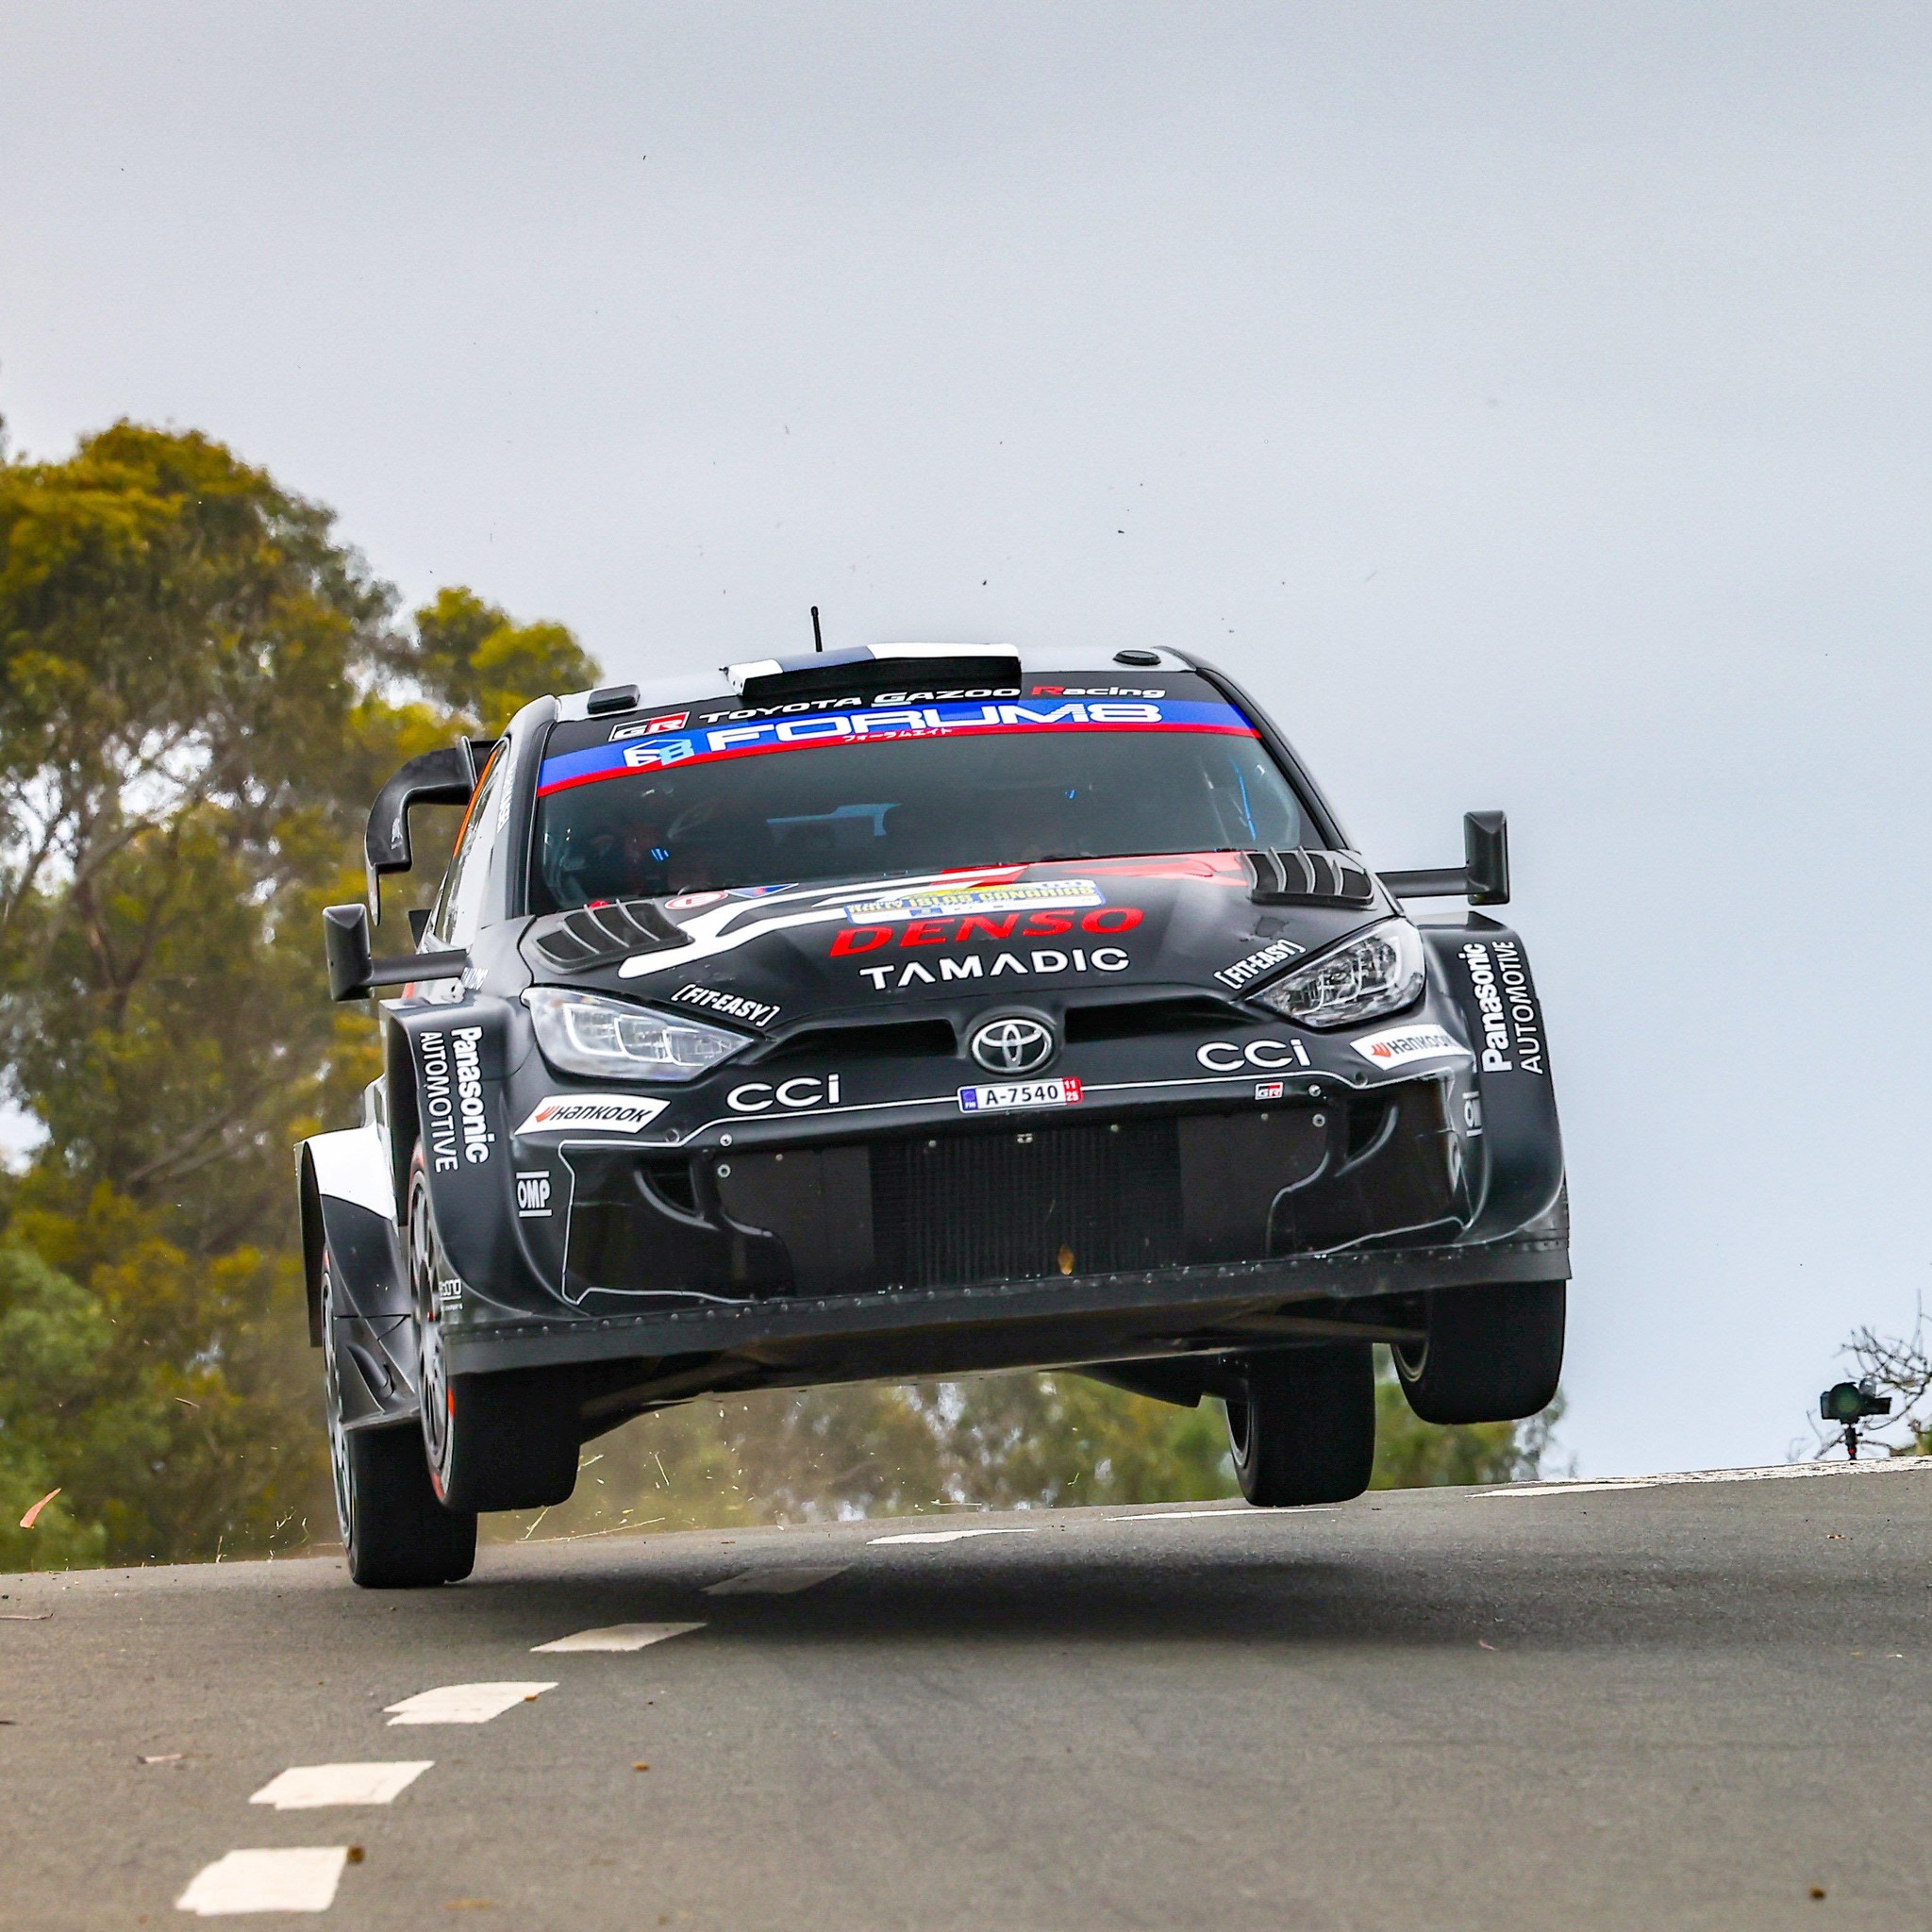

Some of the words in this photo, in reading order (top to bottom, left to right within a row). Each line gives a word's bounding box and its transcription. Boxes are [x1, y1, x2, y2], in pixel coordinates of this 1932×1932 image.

[699, 696, 863, 724] TOYOTA
[872, 687, 1022, 708] GAZOO
[1031, 685, 1167, 700] Racing
[611, 718, 685, 741] GR
[707, 703, 1162, 753] FORUM8
[841, 727, 953, 742] フォーラムエイト
[829, 907, 1145, 958] DENSO
[859, 947, 1130, 991] TAMADIC
[1458, 943, 1514, 1073] Panasonic
[1491, 941, 1544, 1075] AUTOMOTIVE
[419, 1031, 459, 1174] AUTOMOTIVE
[451, 1025, 495, 1165] Panasonic
[985, 1085, 1058, 1106] A-7540
[1064, 1080, 1076, 1090] 11
[517, 1179, 551, 1209] OMP
